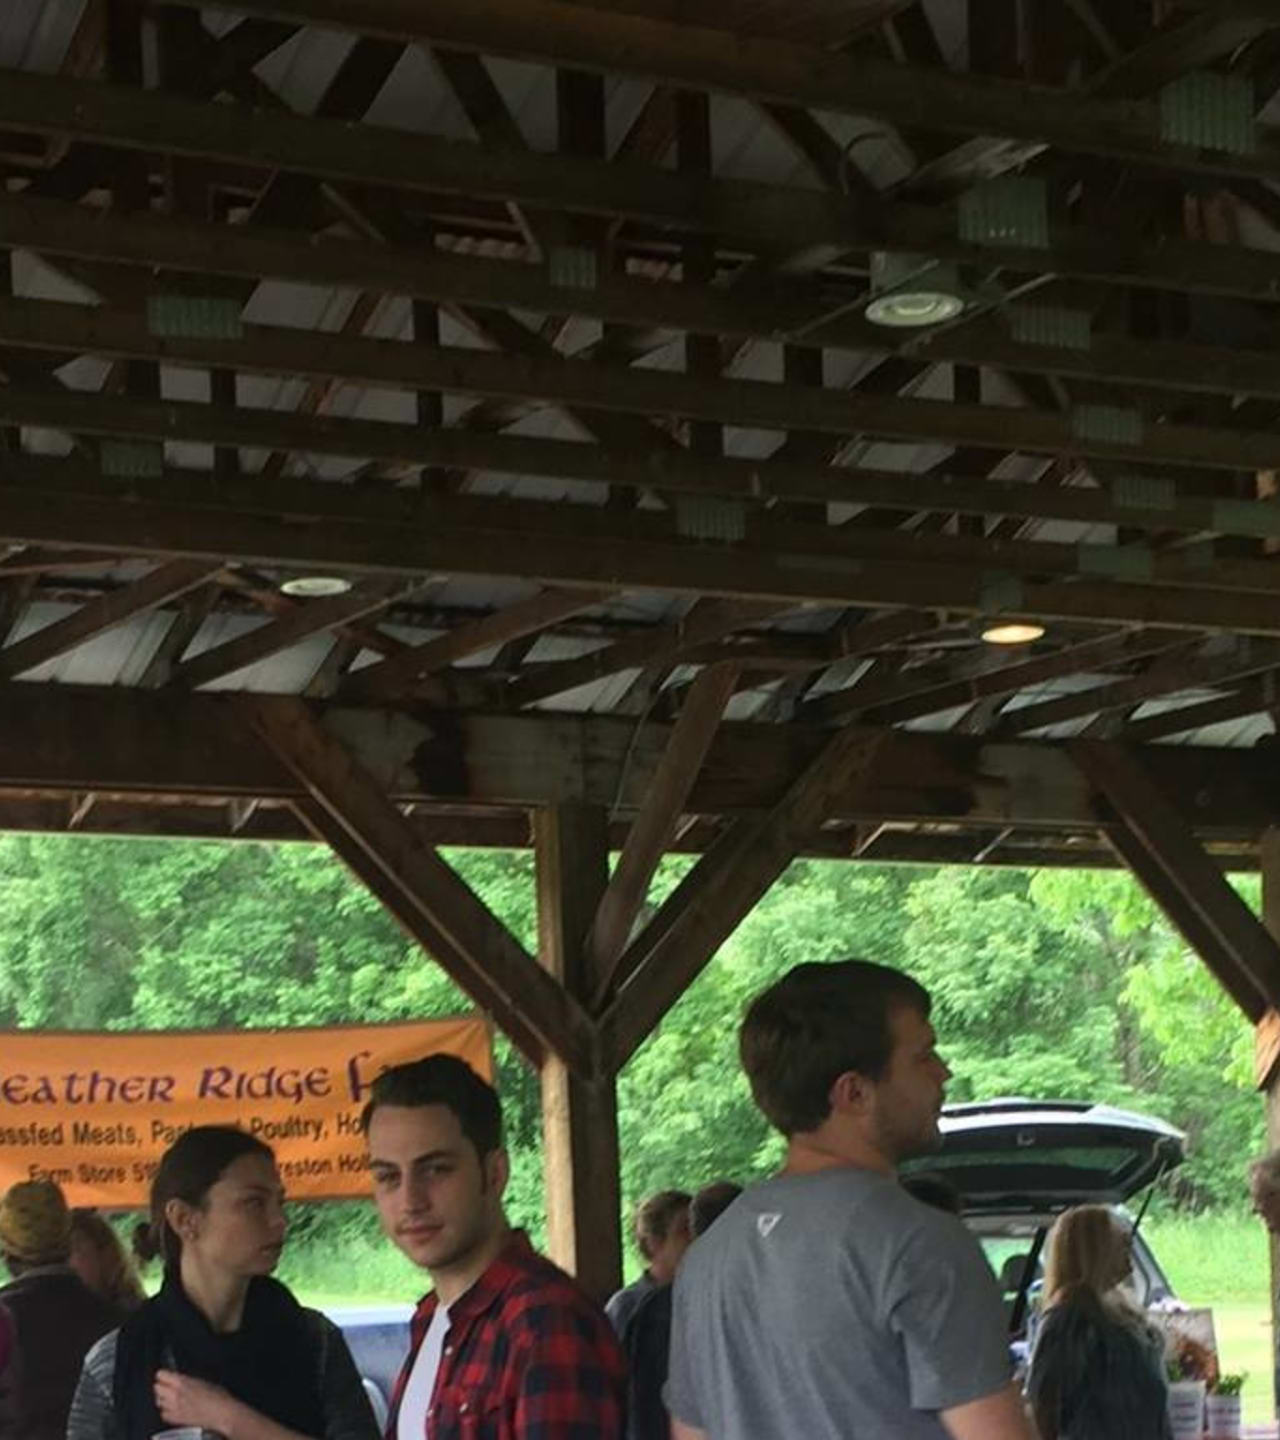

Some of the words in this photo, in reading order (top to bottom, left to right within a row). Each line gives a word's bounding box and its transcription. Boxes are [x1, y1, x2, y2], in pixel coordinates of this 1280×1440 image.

[73, 1119, 143, 1149] Meats,
[250, 1114, 330, 1142] Poultry,
[27, 1163, 75, 1186] Farm
[78, 1161, 128, 1185] Store
